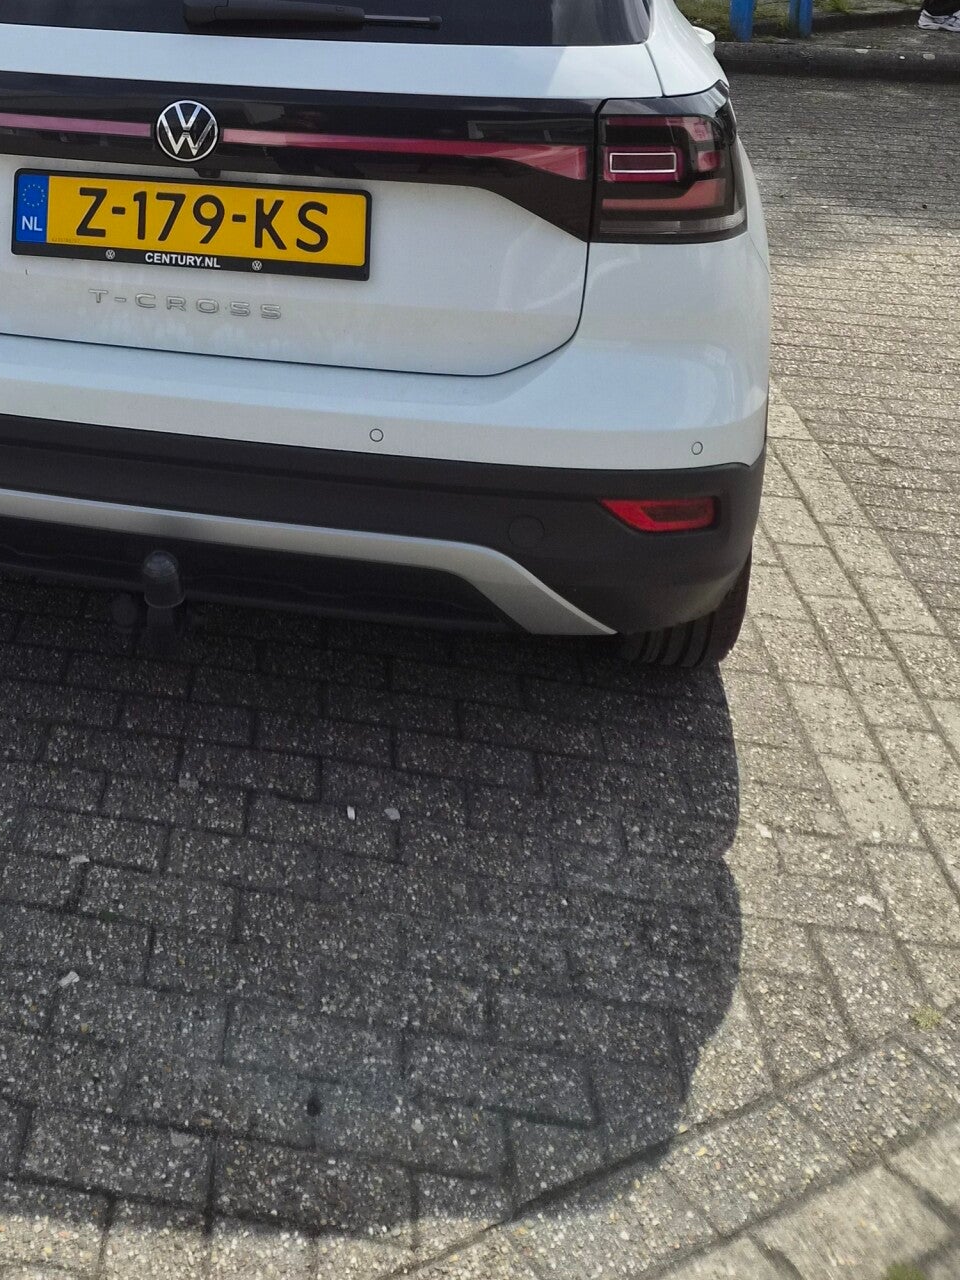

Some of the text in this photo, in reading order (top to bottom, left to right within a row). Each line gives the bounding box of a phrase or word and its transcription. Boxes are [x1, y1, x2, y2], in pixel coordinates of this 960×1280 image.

[21, 215, 43, 232] NL
[75, 186, 330, 254] Z-179-KS
[144, 251, 221, 268] CENTURY.NL
[88, 288, 282, 320] T-CROSS
